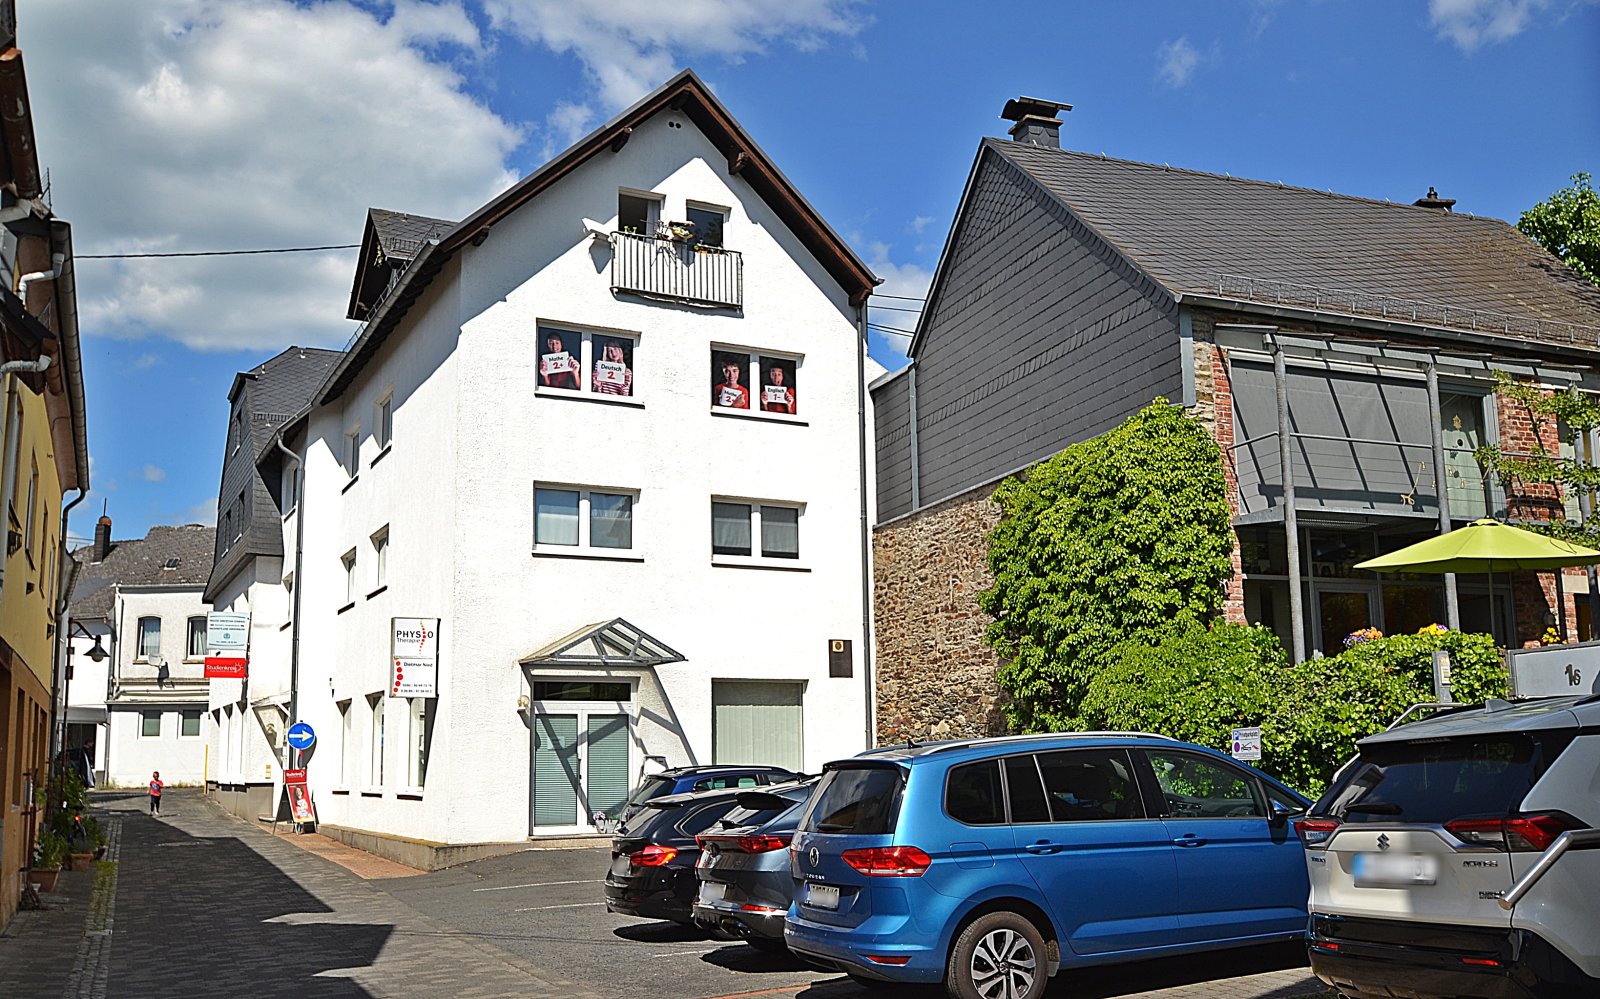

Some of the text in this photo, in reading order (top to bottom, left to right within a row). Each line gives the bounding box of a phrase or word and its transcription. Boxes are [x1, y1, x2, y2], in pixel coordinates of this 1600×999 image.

[601, 363, 622, 372] Deutsch
[607, 371, 616, 380] 2
[1565, 664, 1581, 686] 16
